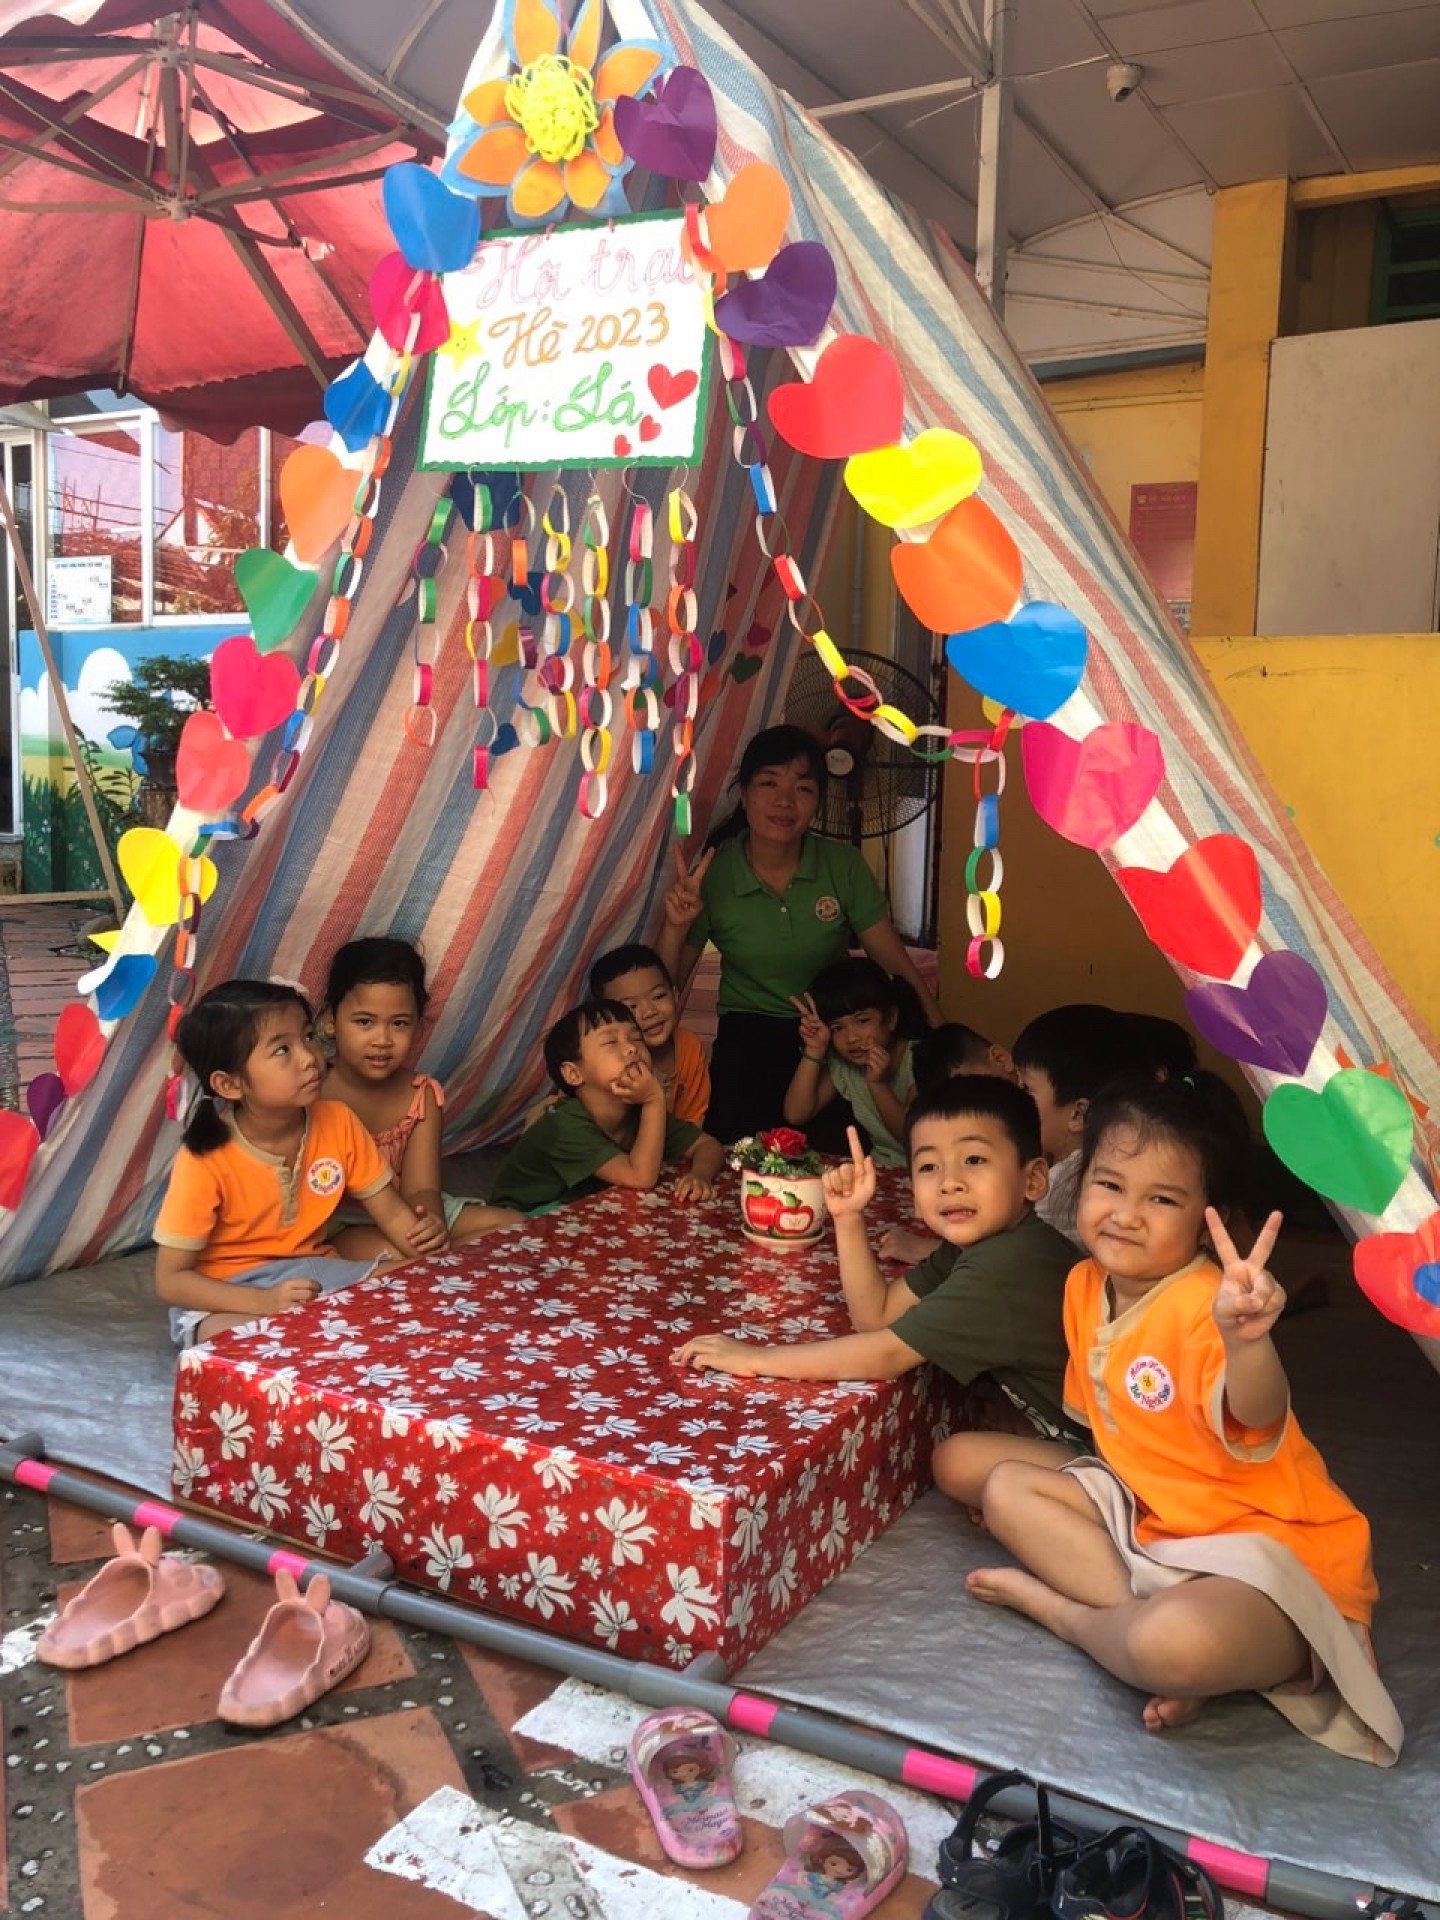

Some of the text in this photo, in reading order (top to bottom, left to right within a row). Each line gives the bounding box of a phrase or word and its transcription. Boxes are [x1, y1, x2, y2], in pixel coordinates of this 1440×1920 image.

[488, 301, 670, 369] Hè 2023
[553, 361, 644, 433] Lá
